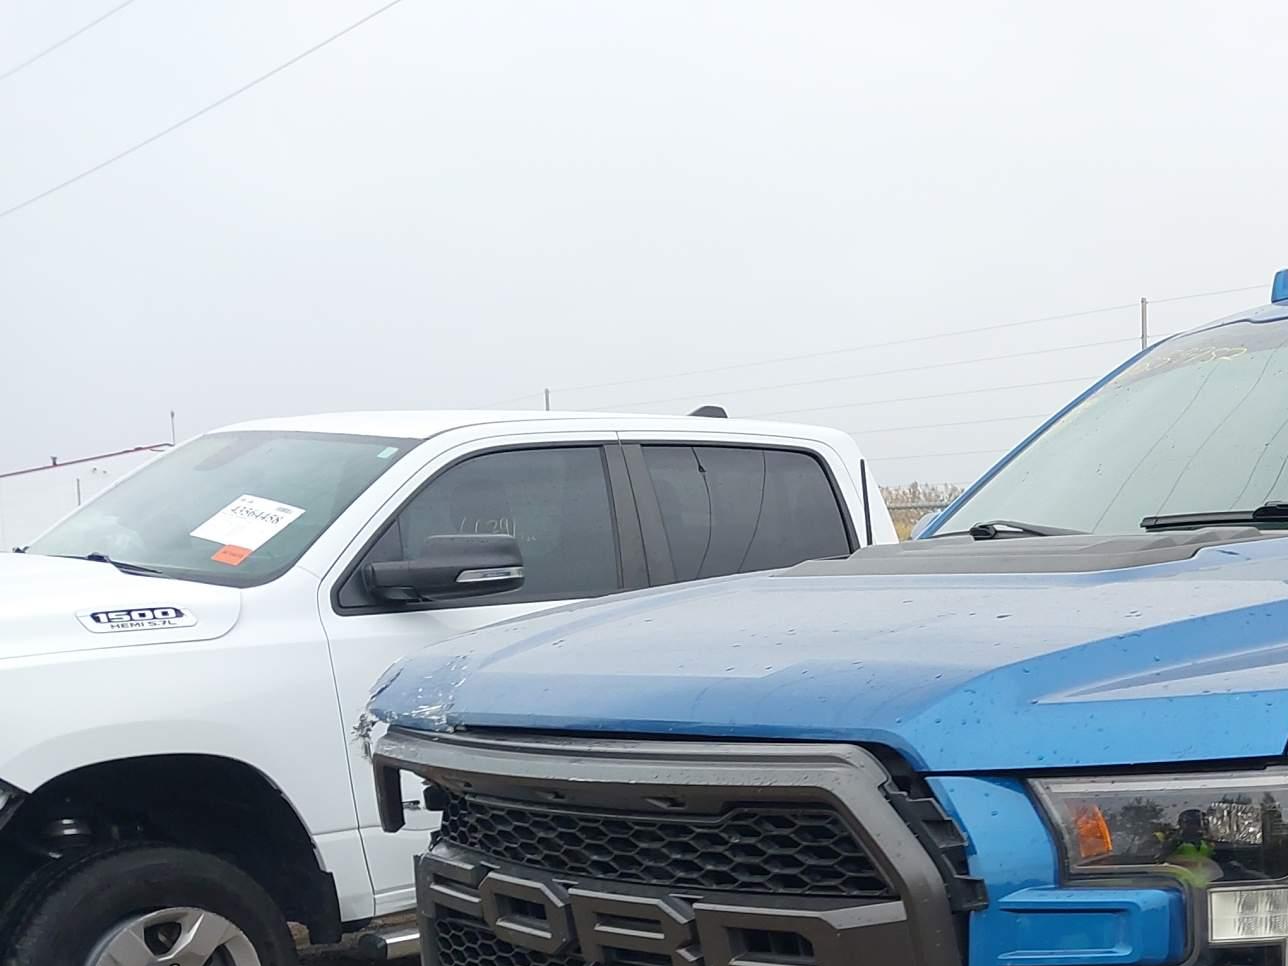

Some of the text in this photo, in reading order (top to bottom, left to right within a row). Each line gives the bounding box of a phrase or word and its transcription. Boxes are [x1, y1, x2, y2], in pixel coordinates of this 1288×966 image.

[93, 607, 177, 623] 1500
[110, 619, 178, 630] HEMI 5.7L
